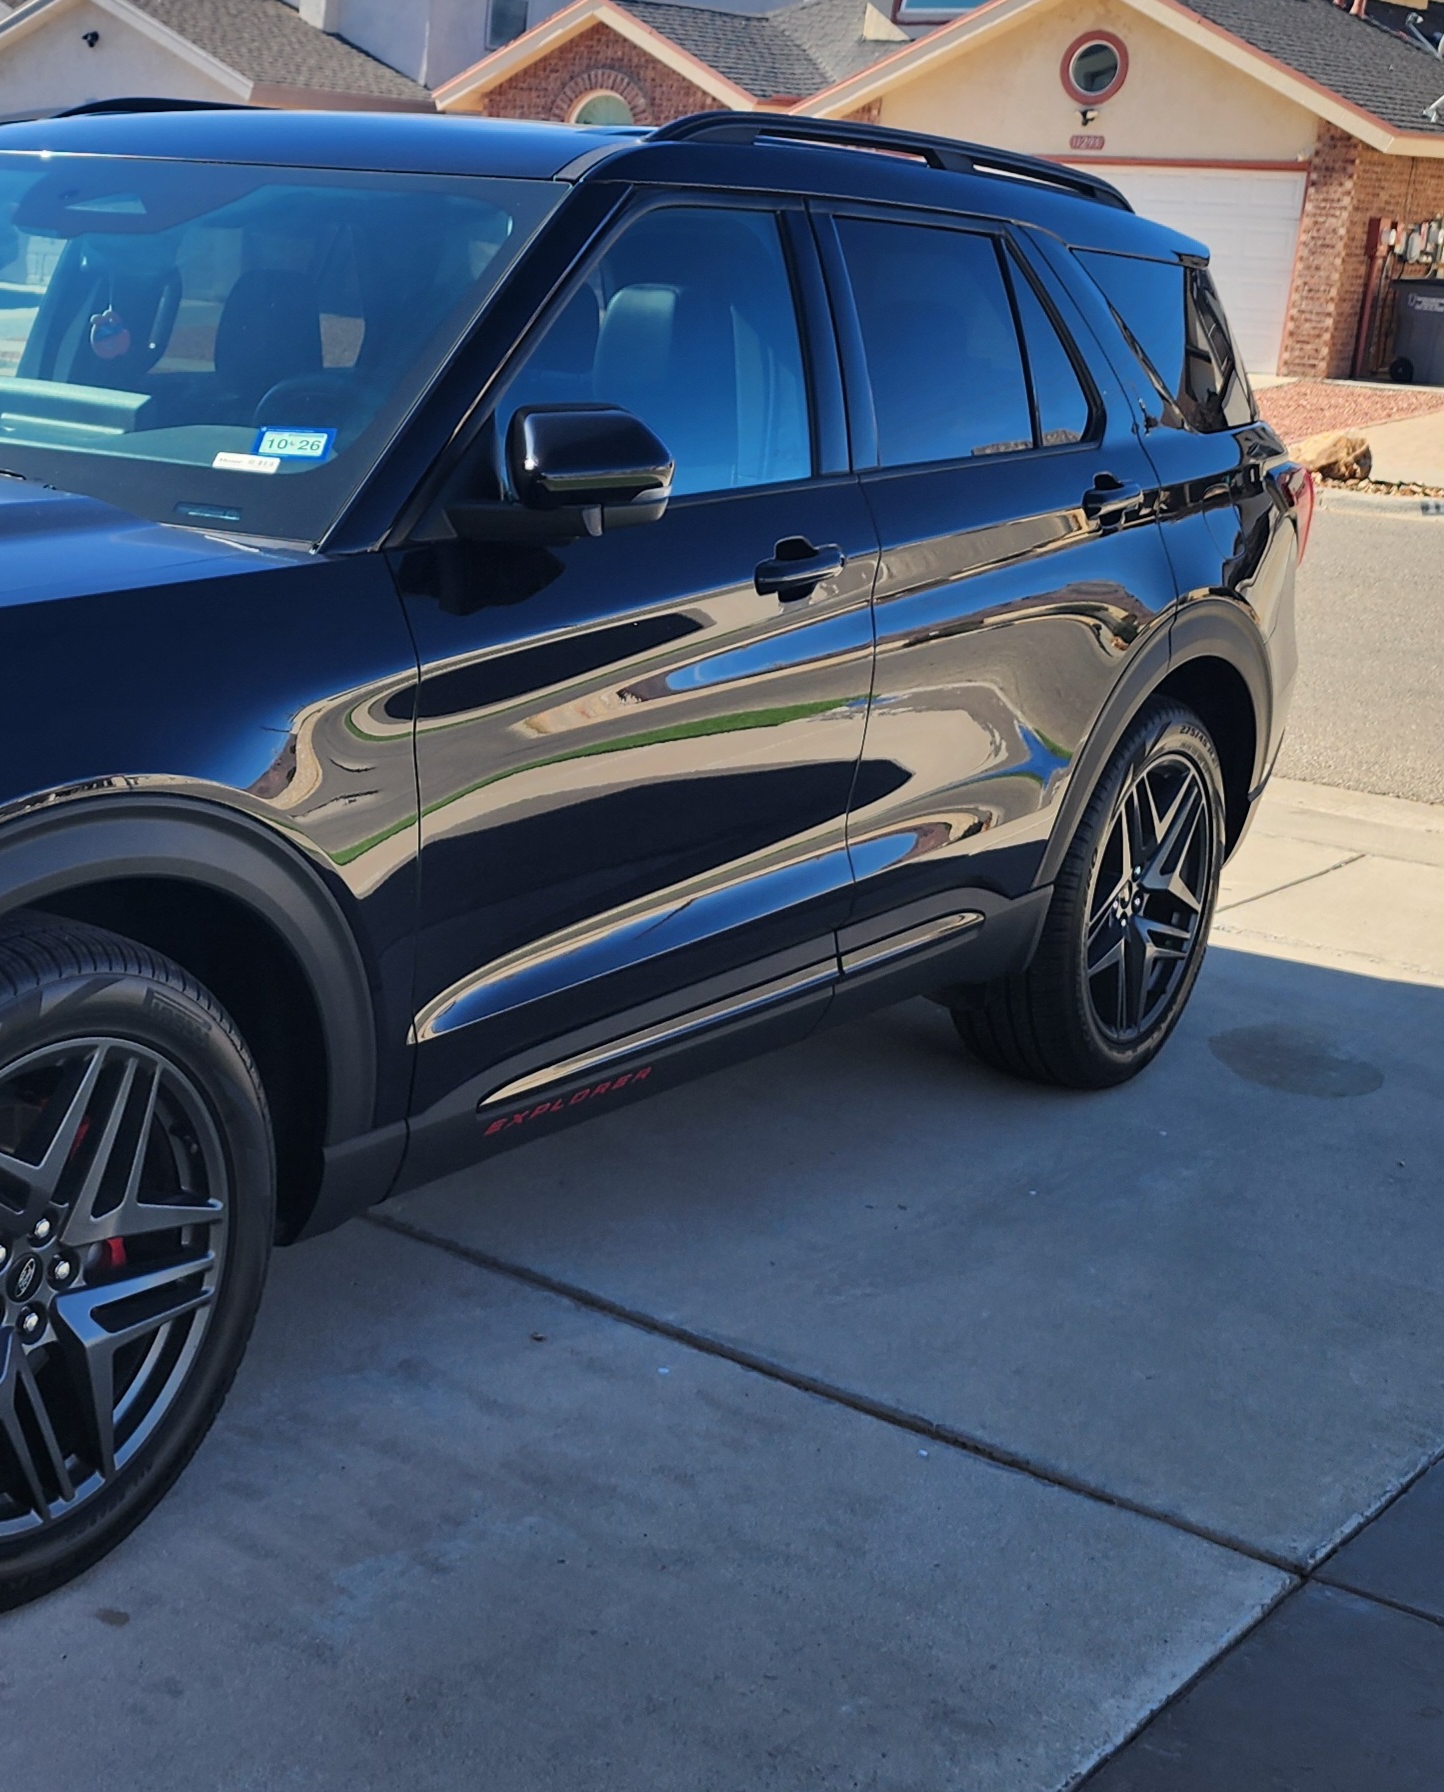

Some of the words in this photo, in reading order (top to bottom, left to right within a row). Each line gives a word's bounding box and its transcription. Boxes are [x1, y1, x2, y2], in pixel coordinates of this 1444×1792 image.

[267, 438, 289, 450] 10
[296, 439, 322, 451] 26
[483, 1066, 653, 1137] EXPLORER
